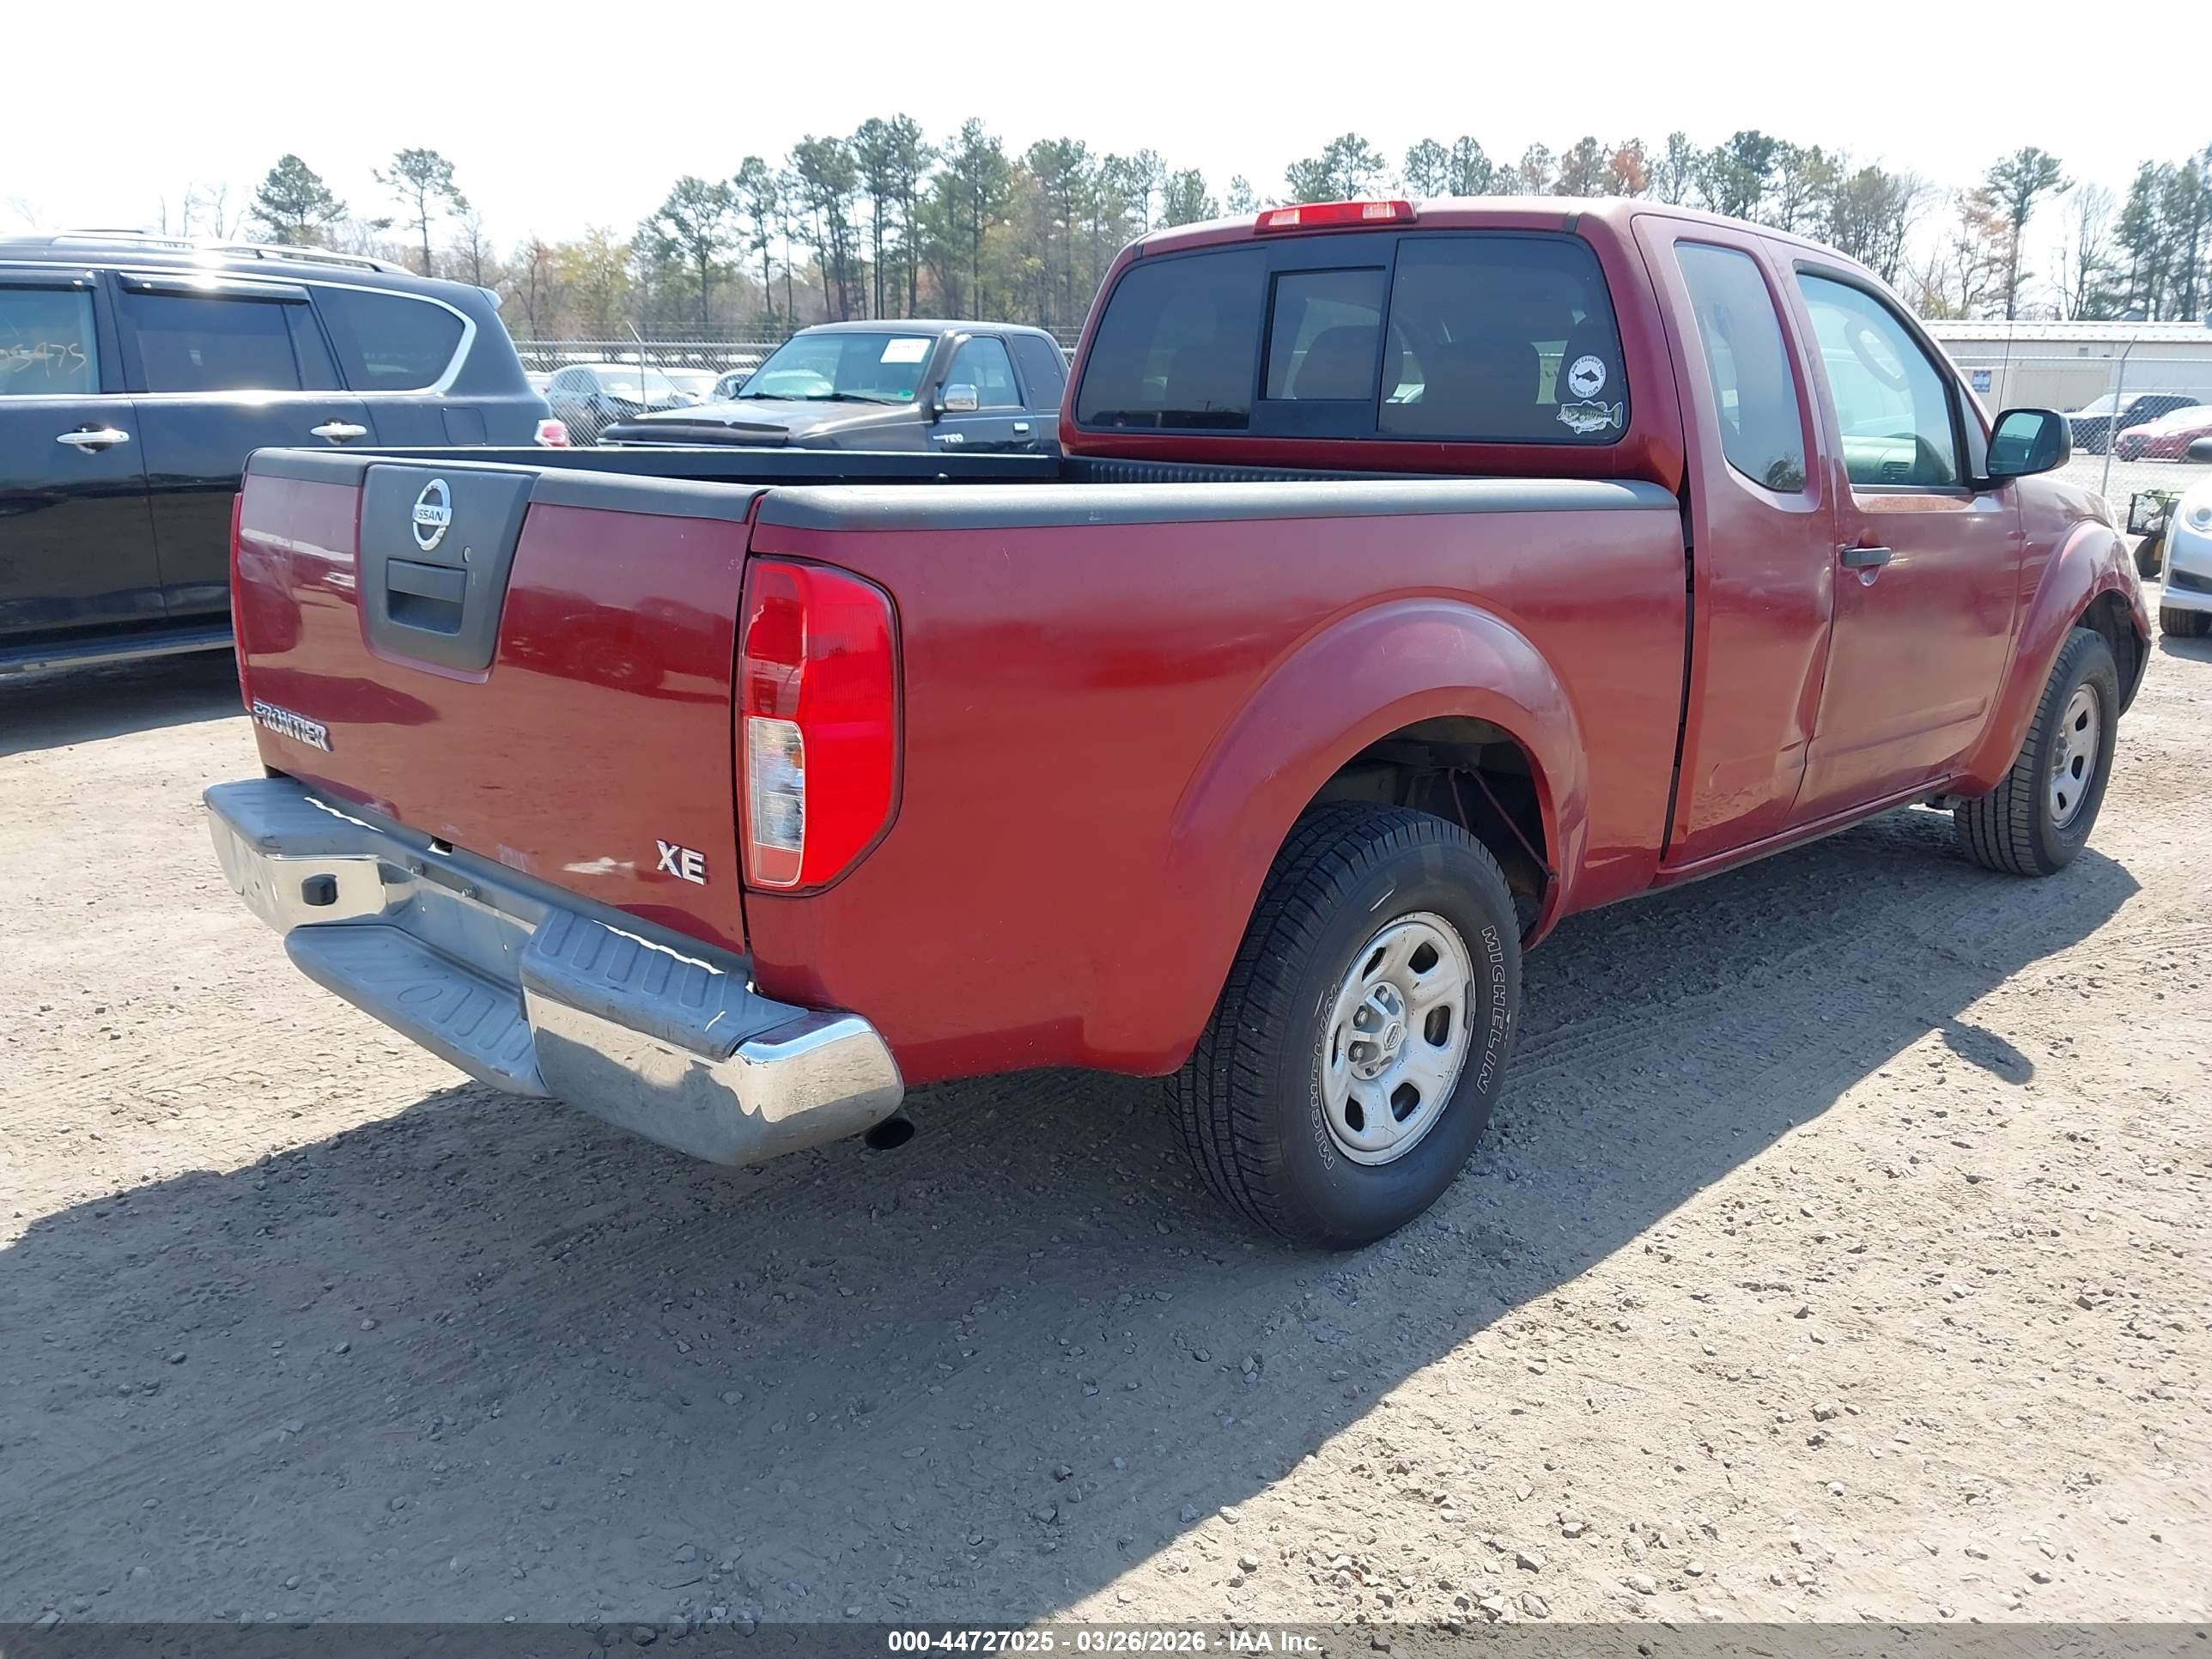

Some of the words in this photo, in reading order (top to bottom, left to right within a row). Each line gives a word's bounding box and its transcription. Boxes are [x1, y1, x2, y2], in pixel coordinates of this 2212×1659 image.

[413, 507, 444, 522] SSAN
[252, 700, 331, 752] FRONTIER
[655, 839, 708, 886] XE
[1477, 924, 1506, 1096] MICHELIN
